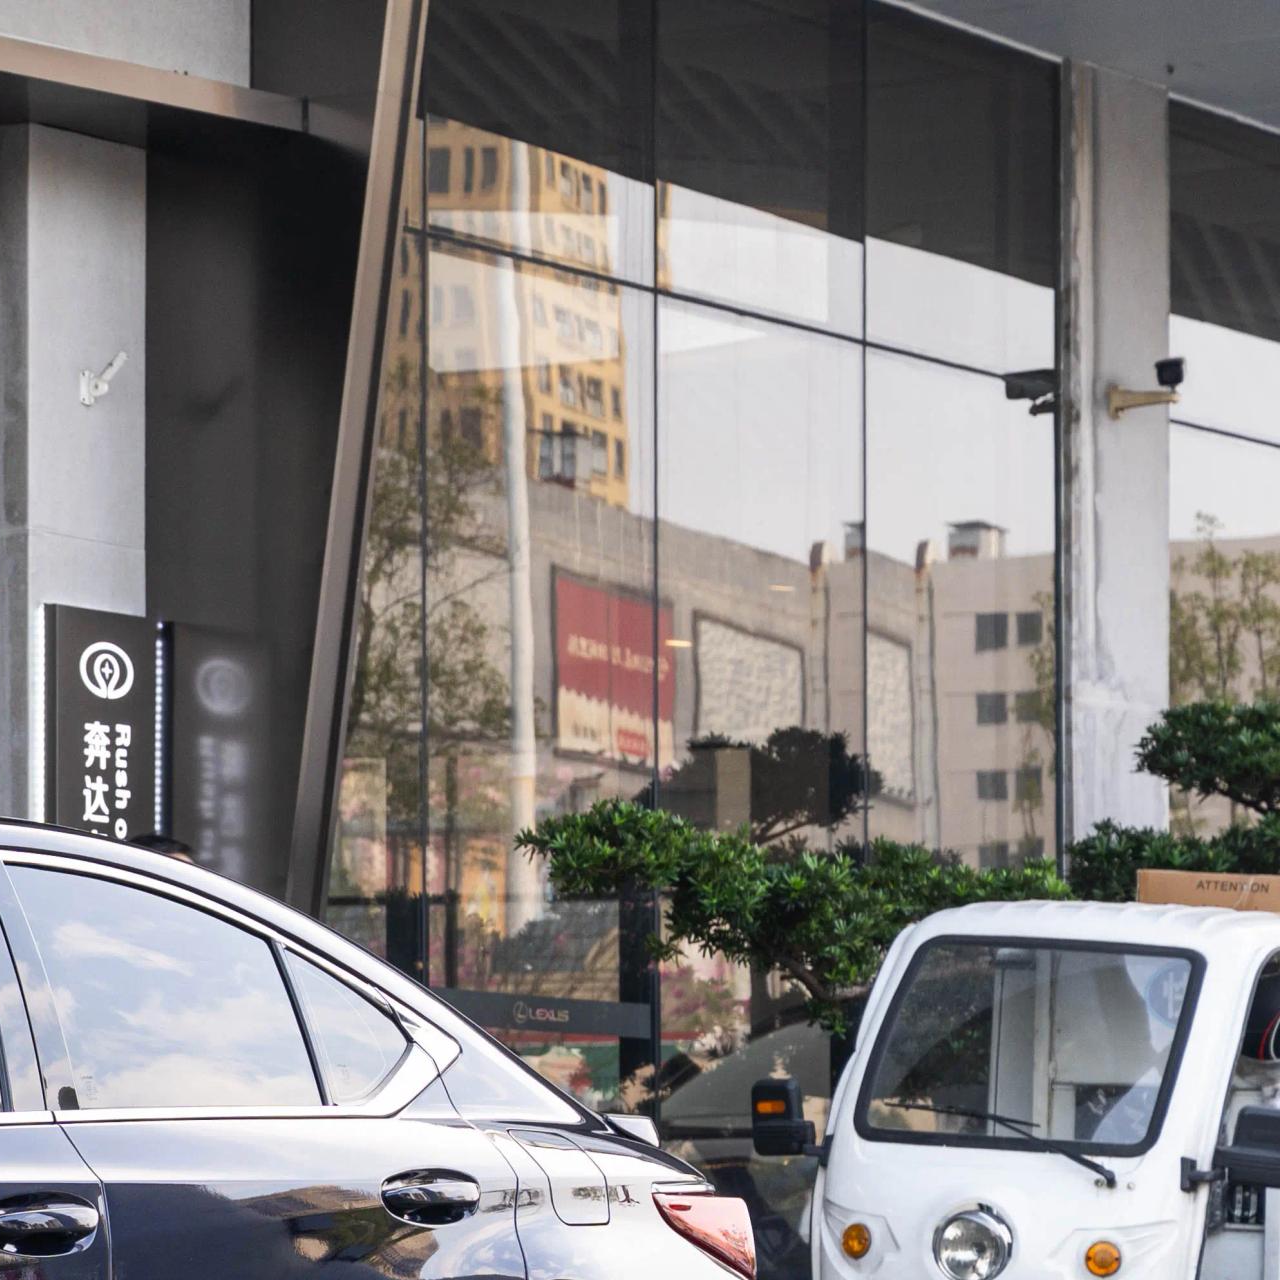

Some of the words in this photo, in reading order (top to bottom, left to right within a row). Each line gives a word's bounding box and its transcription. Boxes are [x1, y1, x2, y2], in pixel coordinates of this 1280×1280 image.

[82, 720, 111, 837] 奔达
[114, 723, 132, 810] Rush
[1195, 879, 1271, 894] ATTENTON
[528, 1007, 570, 1023] LEXUS
